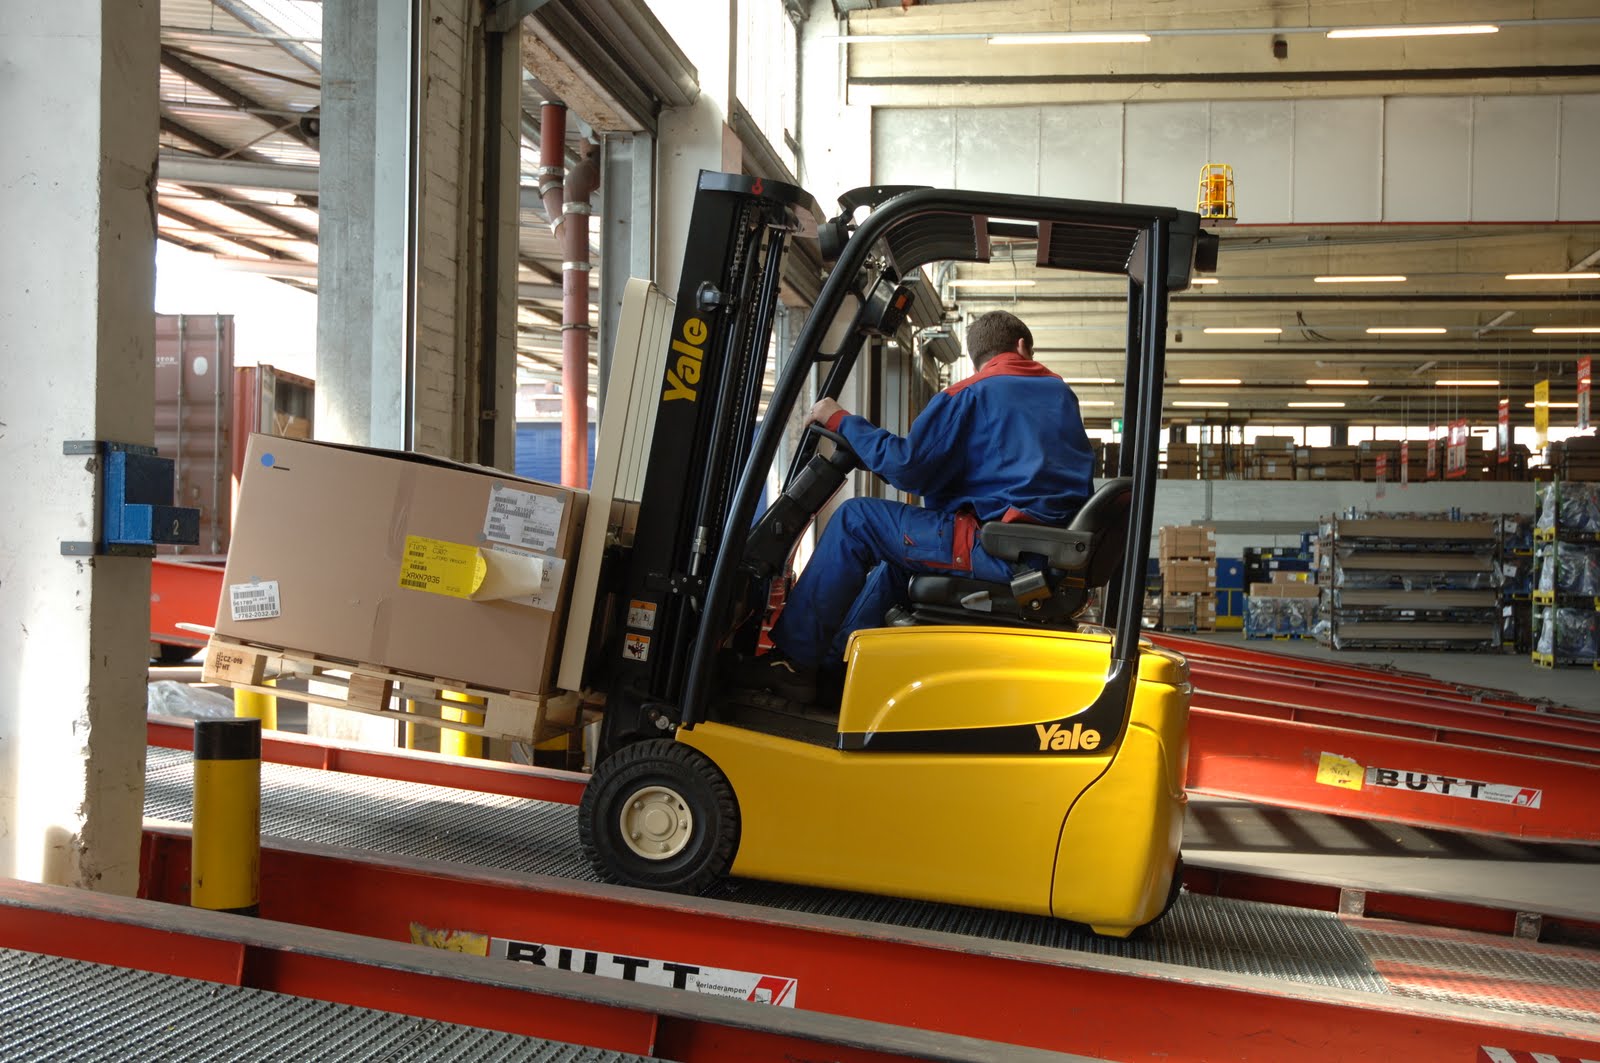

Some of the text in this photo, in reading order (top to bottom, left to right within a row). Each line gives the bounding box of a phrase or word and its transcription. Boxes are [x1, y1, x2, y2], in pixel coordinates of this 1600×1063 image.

[663, 317, 708, 402] Yale
[173, 519, 180, 536] 2
[1035, 723, 1101, 751] Yale
[1376, 768, 1487, 799] BUTT
[506, 941, 700, 990] BUTT
[695, 980, 747, 995] Verladerampen
